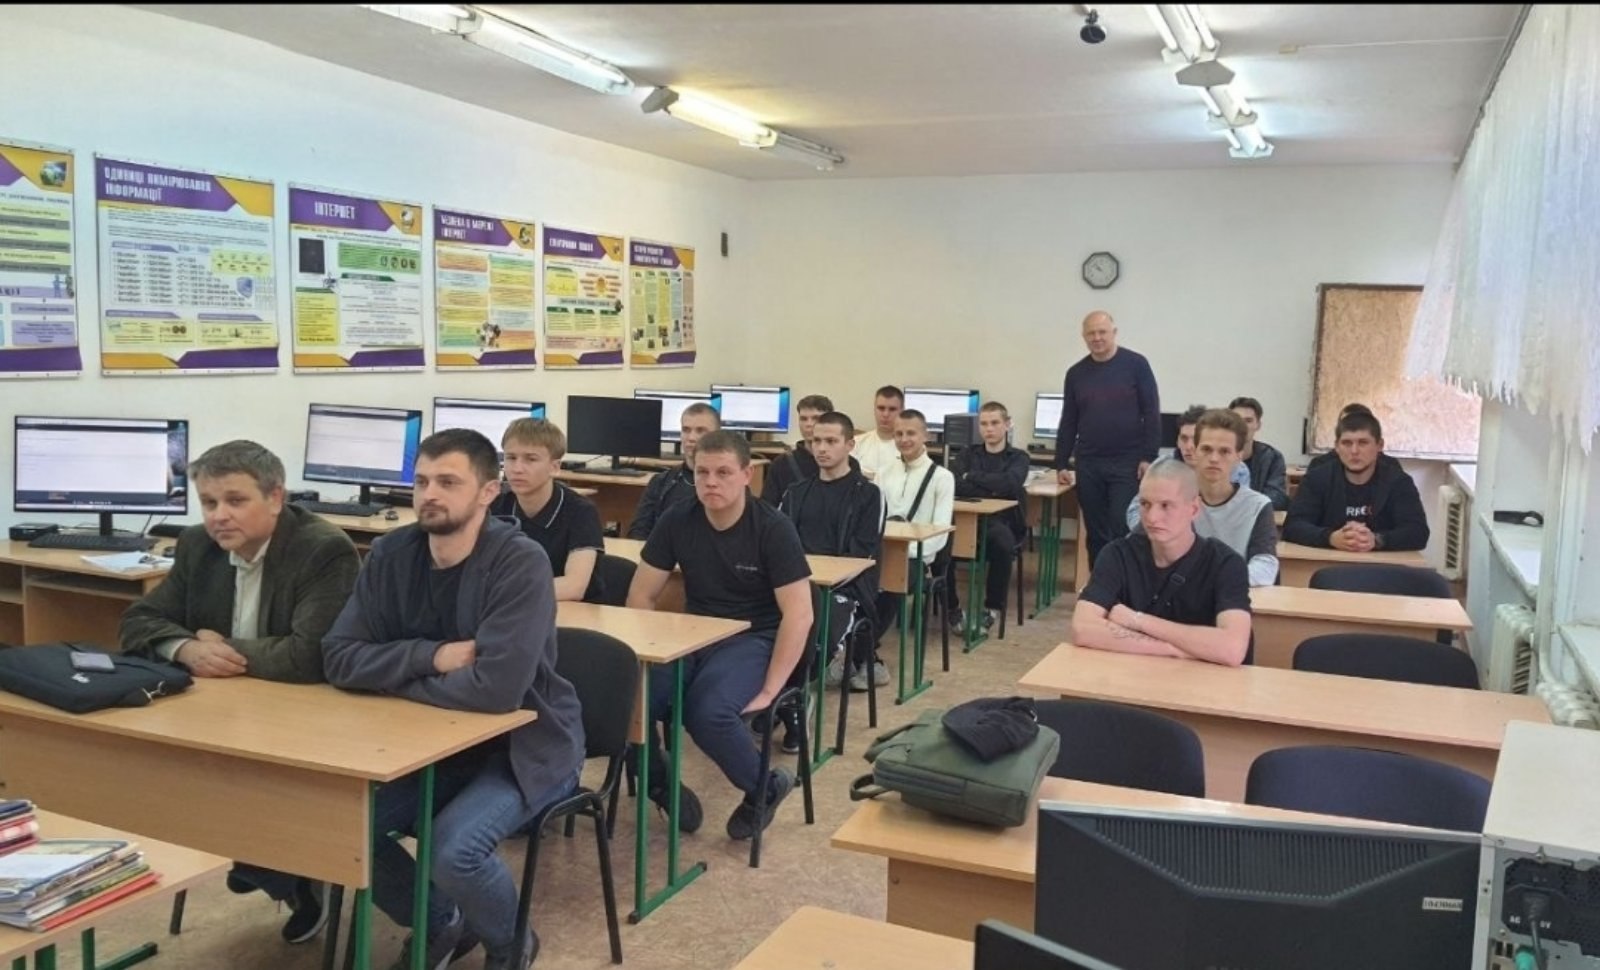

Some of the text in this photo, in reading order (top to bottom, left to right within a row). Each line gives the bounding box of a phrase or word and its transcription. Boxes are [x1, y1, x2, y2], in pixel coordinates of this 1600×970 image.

[104, 166, 211, 192] ОДИНИЦІ ВИМІРЮВАННЯ
[105, 182, 162, 202] ІНФОРМАЦІЇ
[314, 201, 356, 221] ІНТЕРНЕТ
